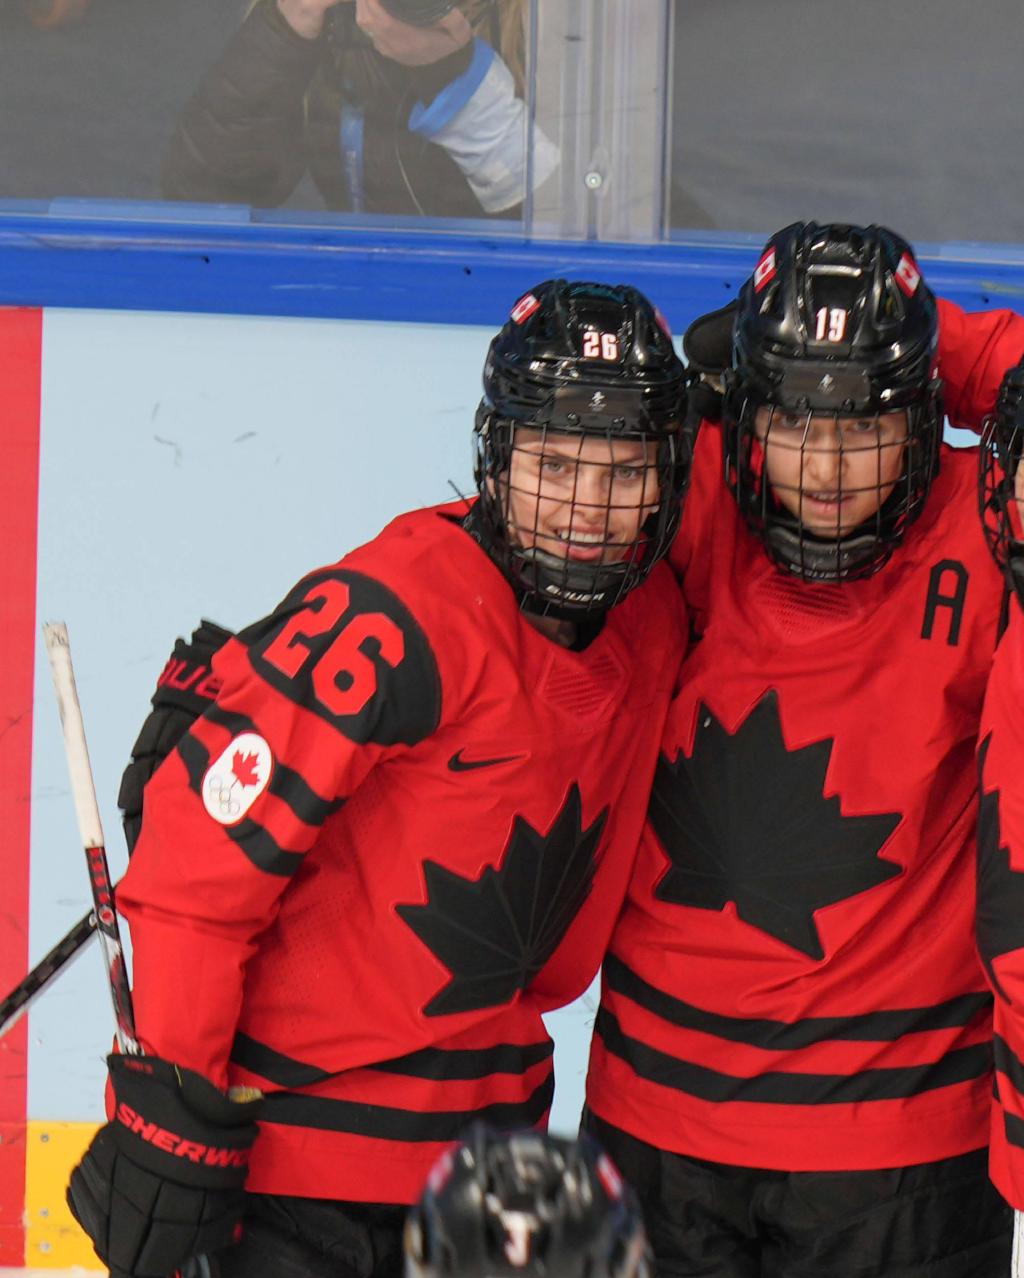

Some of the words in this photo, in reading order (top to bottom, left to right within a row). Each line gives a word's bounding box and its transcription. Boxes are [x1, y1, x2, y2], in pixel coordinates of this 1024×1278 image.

[583, 330, 618, 360] 26
[815, 306, 848, 343] 19
[920, 559, 969, 646] A
[262, 579, 404, 716] 26
